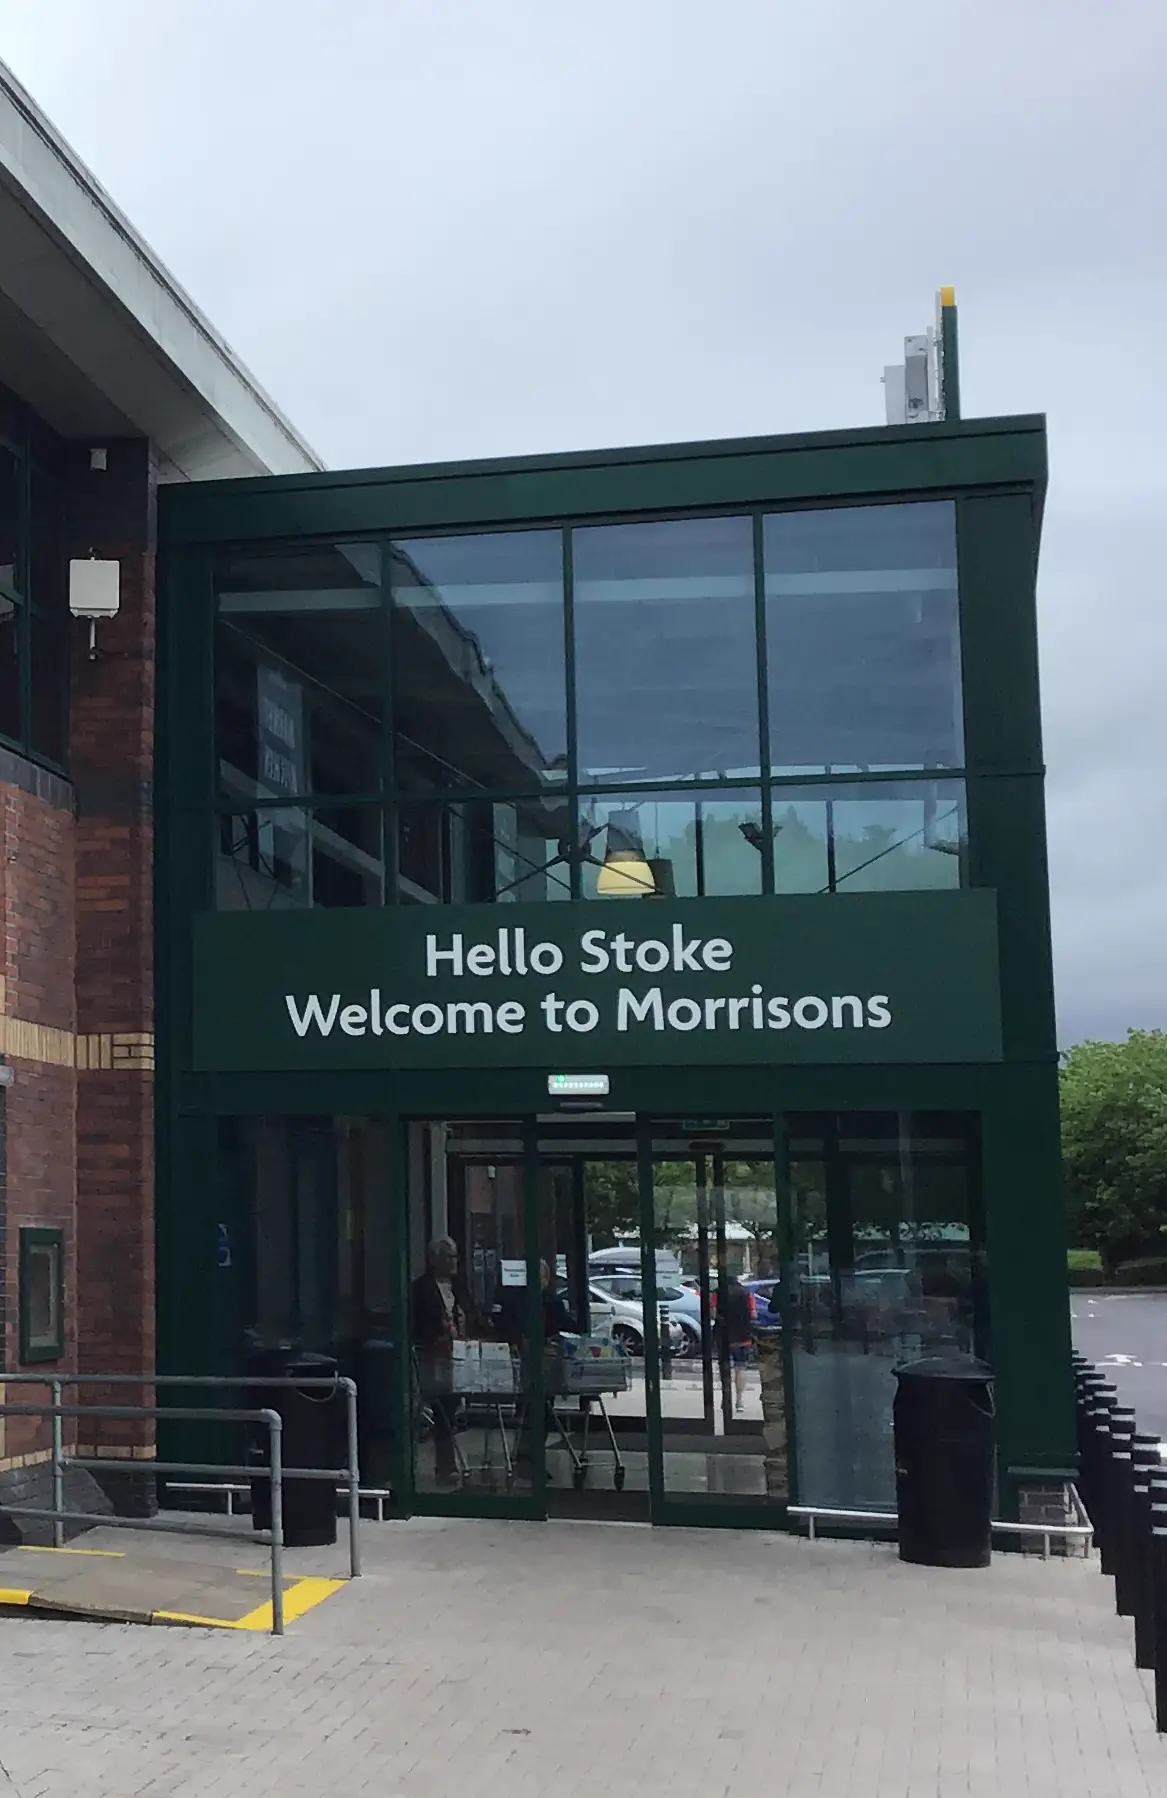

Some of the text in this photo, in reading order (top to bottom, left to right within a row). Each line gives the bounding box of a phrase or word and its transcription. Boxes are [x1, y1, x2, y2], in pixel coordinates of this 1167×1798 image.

[426, 923, 733, 977] Hello Stoke
[285, 984, 892, 1037] Welcome to Morrisons
